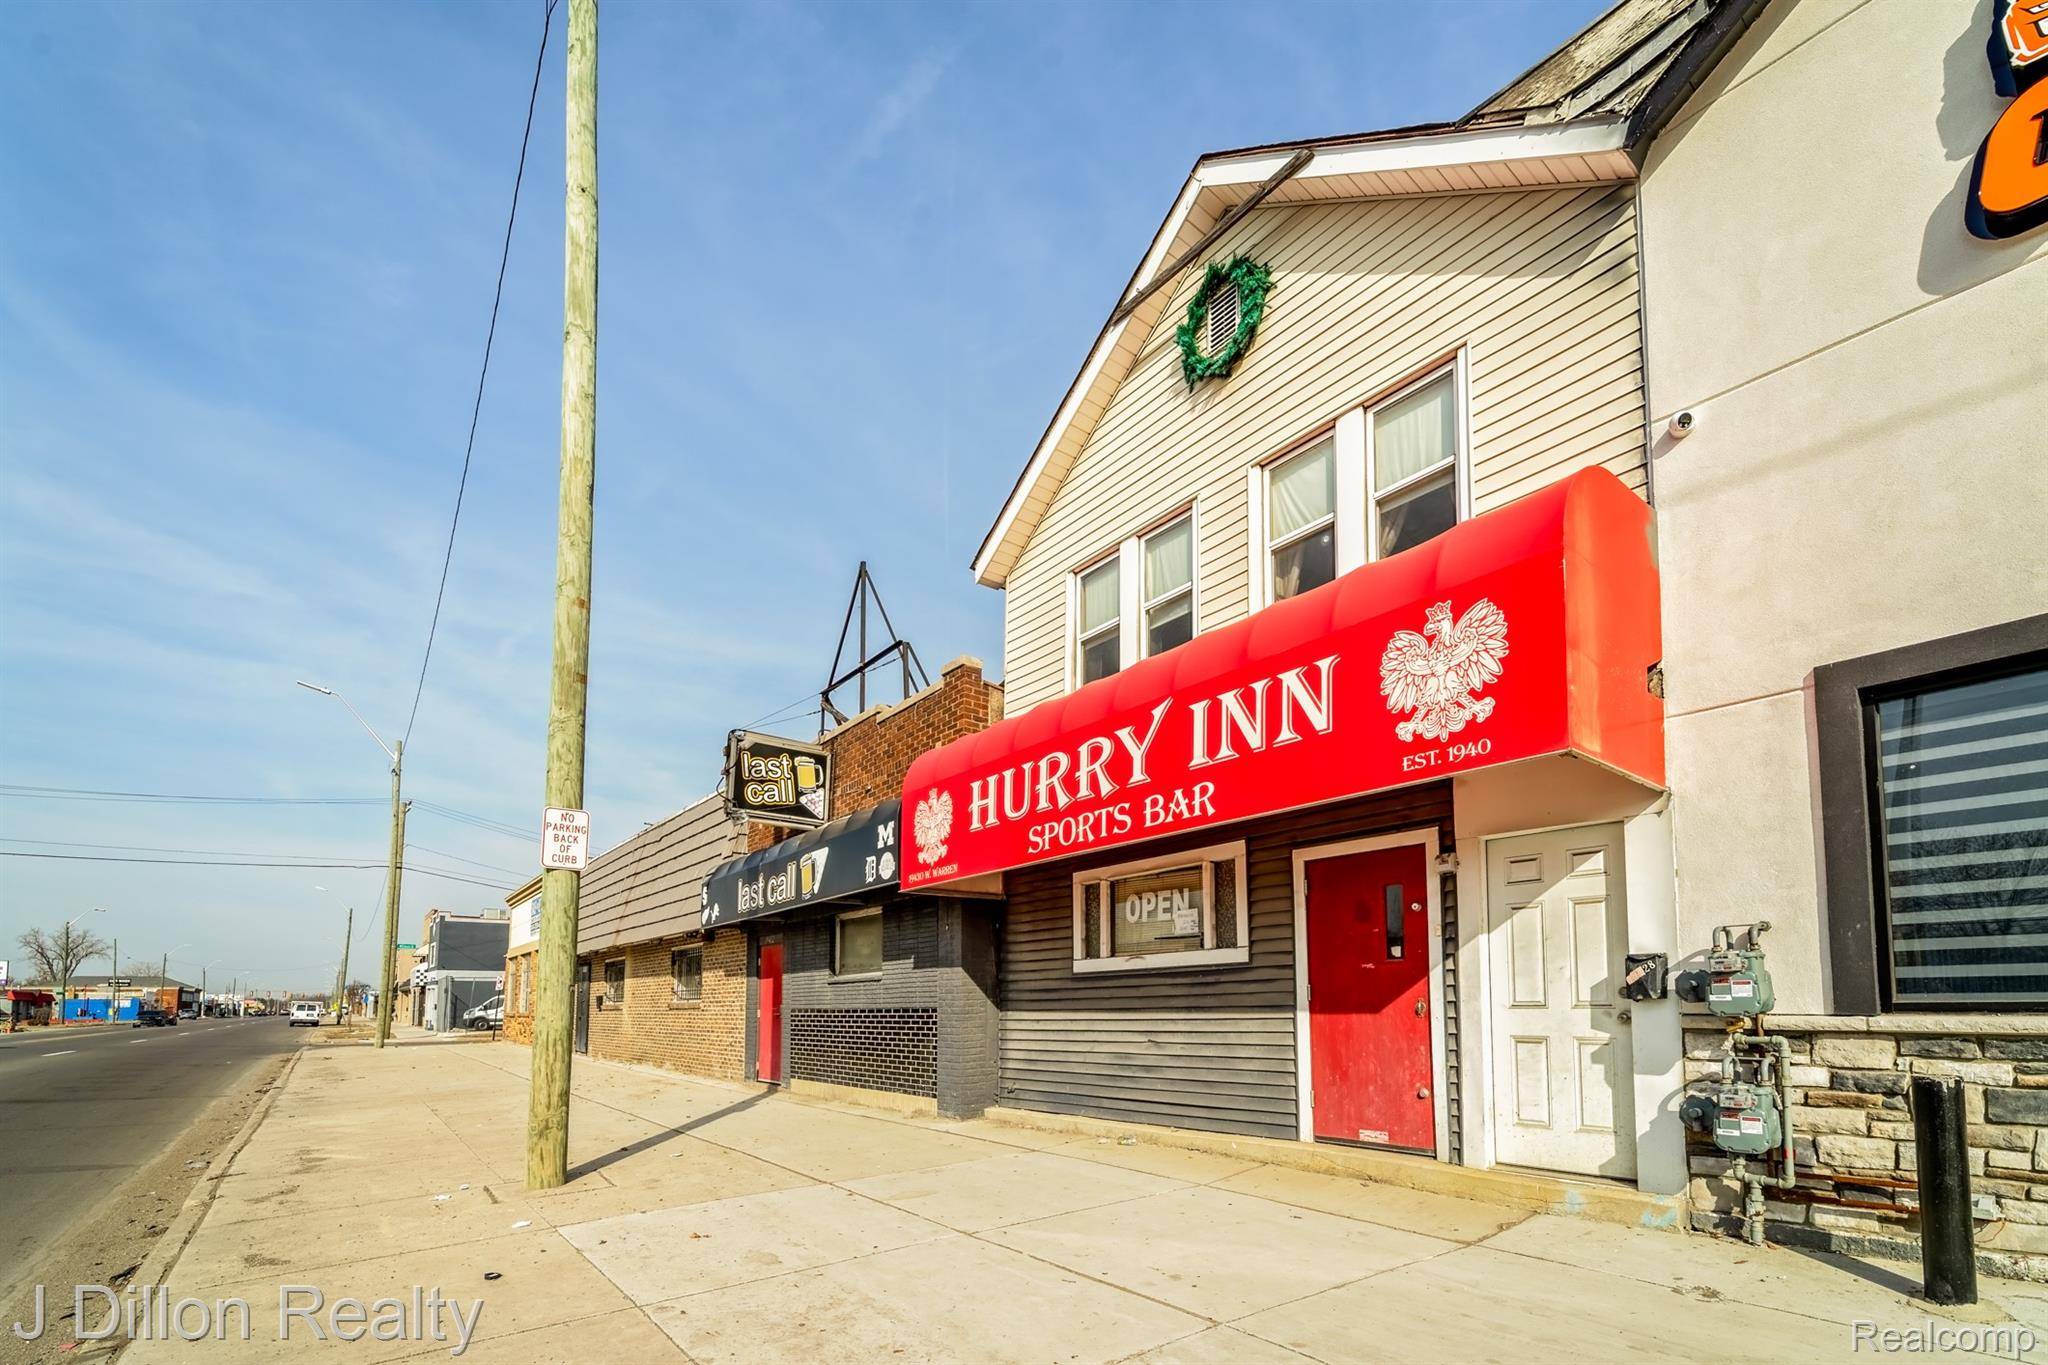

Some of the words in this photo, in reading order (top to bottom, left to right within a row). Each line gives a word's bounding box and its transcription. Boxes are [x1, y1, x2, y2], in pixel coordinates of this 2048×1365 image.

[968, 696, 1173, 832] HURRY
[1188, 653, 1341, 771] INN
[1402, 749, 1442, 772] EST.
[1446, 738, 1491, 763] 1940
[741, 751, 794, 779] last
[745, 779, 796, 805] call
[546, 822, 587, 834] PARKING
[561, 812, 575, 823] NO
[1027, 803, 1132, 854] SPORTS
[1143, 781, 1216, 828] BAR
[553, 833, 579, 844] BACK
[877, 820, 895, 849] M
[551, 854, 577, 864] CURB
[560, 844, 571, 853] OF
[932, 864, 958, 878] WARREN
[737, 873, 765, 914] last
[767, 861, 797, 906] call
[1126, 888, 1189, 923] OPEN
